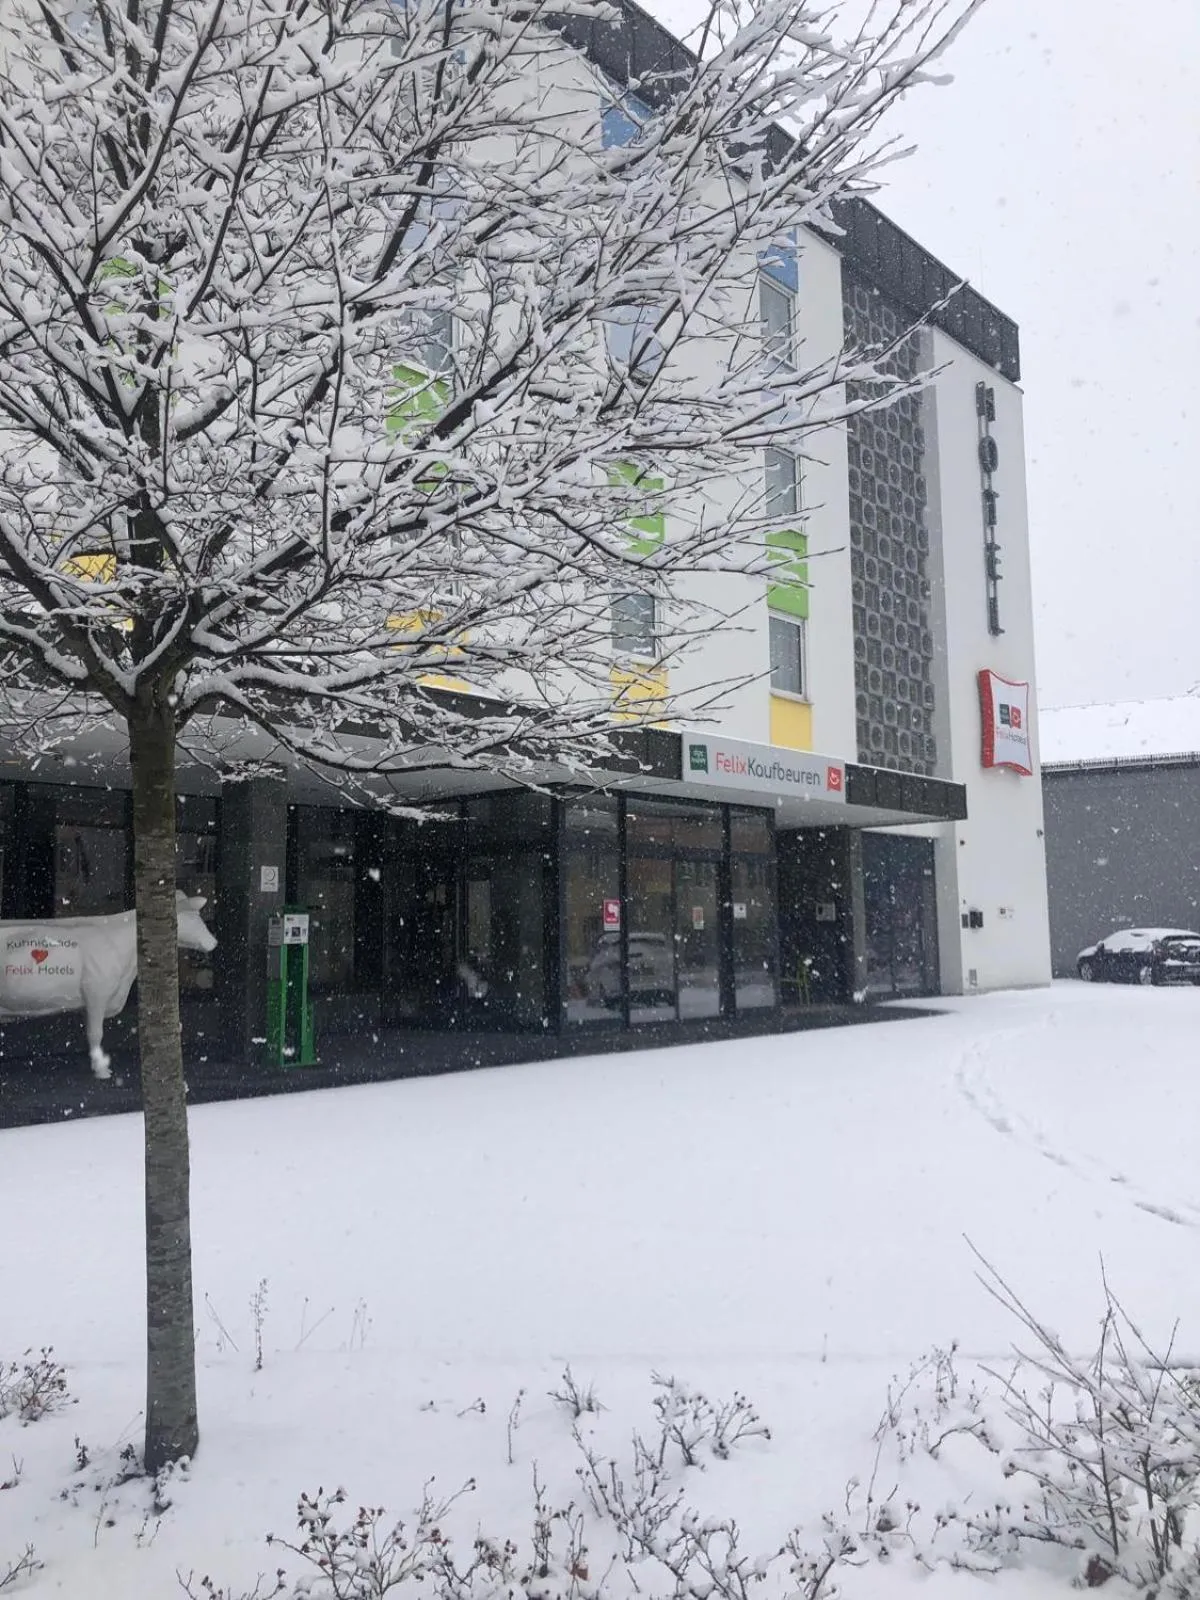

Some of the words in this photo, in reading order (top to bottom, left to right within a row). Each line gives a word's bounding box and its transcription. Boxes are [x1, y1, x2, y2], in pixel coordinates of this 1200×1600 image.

[976, 381, 1005, 636] HOTEL
[5, 965, 33, 976] Felix
[38, 965, 75, 976] Hotels
